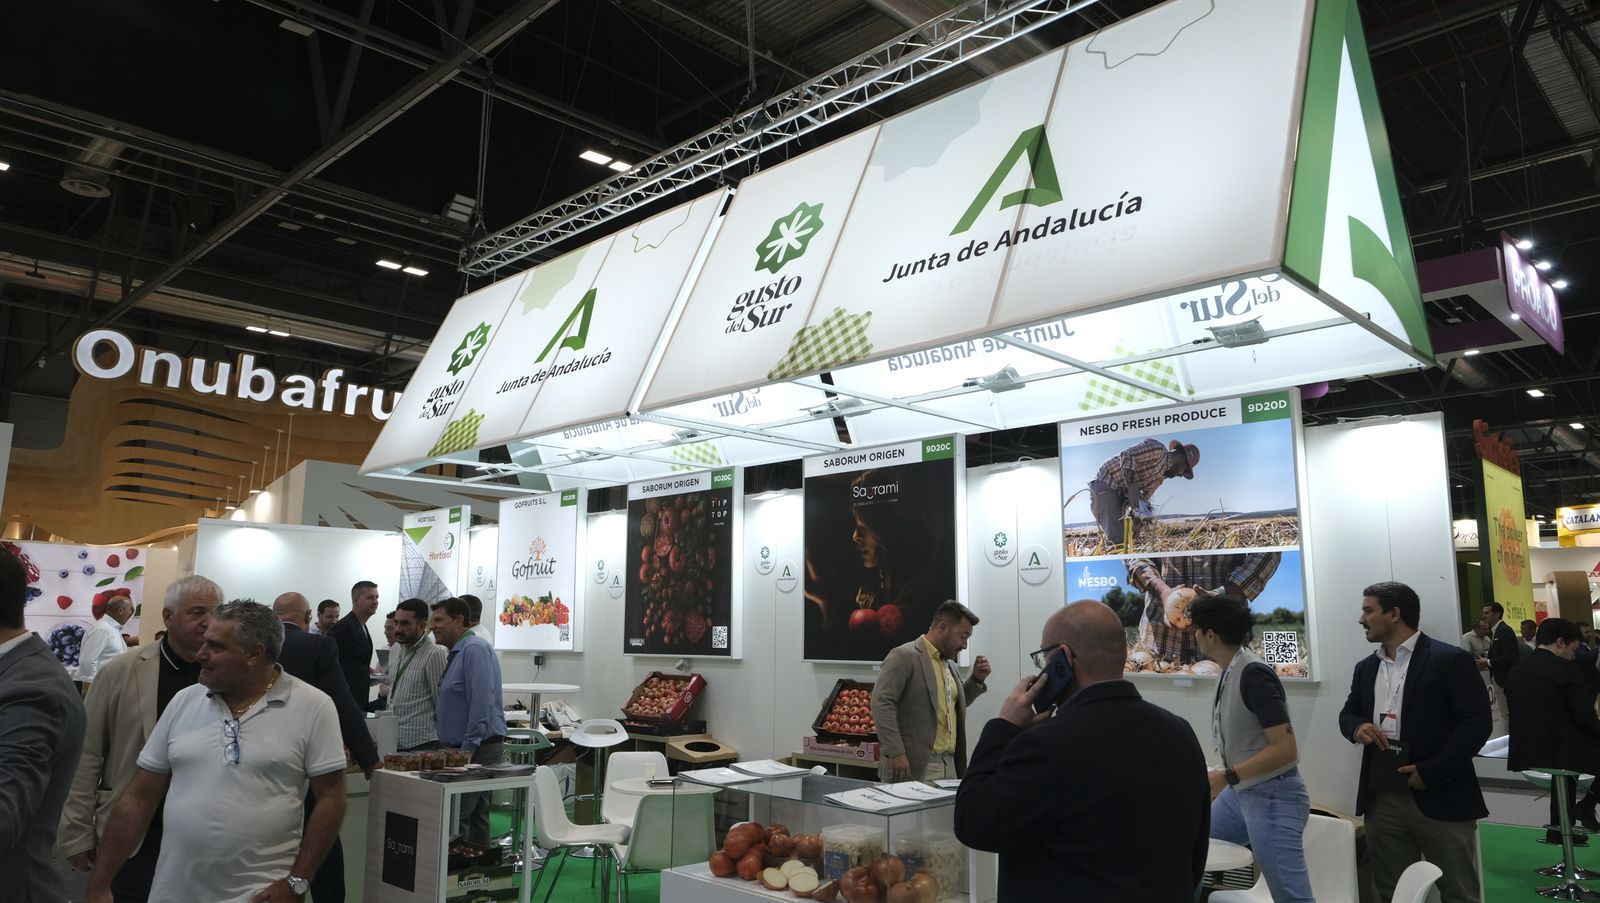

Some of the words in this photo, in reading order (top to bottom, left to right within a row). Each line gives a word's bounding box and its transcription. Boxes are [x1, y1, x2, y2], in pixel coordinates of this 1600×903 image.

[882, 252, 951, 283] Junta
[957, 240, 989, 263] de
[993, 191, 1143, 251] Andalucía
[727, 274, 802, 321] gusto
[725, 318, 744, 334] del
[741, 303, 793, 332] Sur
[496, 374, 529, 394] Junta
[531, 369, 547, 384] de
[546, 347, 612, 379] Andalucía
[423, 378, 464, 409] gusto
[427, 399, 454, 419] Sur
[1247, 400, 1287, 413] 9D20D
[1080, 422, 1119, 436] NESBO
[1122, 416, 1160, 431] FRESH
[1164, 407, 1227, 425] PRODUCE
[926, 442, 951, 453] 9D20C
[824, 454, 867, 468] SABORUM
[869, 448, 905, 462] ORIGEN
[642, 483, 672, 493] SABORUM
[674, 478, 700, 489] ORIGEN
[514, 499, 538, 509] GOFRUITS
[429, 551, 452, 560] Hortisol
[512, 556, 557, 580] Gofruit
[1078, 576, 1118, 588] NESBO
